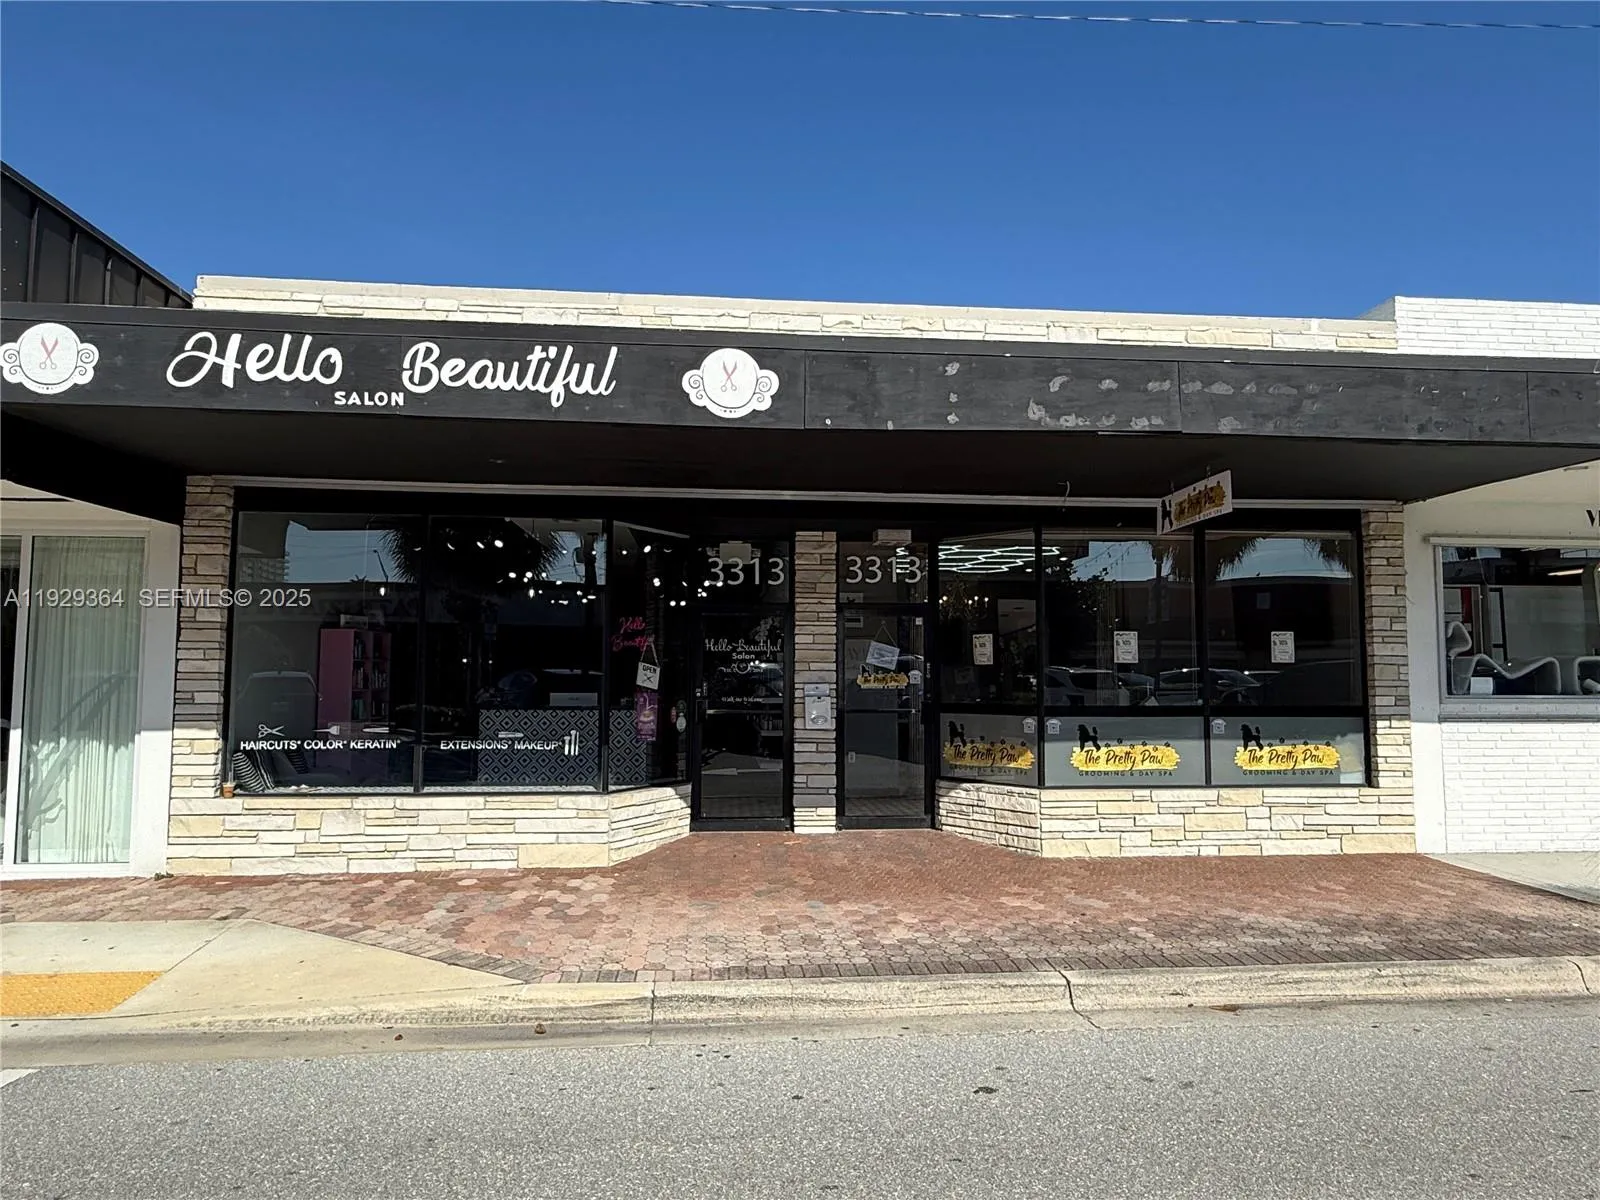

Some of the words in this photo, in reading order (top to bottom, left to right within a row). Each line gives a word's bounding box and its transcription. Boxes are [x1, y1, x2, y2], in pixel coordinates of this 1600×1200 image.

[166, 331, 343, 389] Hello
[402, 341, 618, 408] Beautiful
[334, 390, 405, 407] SALON
[707, 556, 785, 586] 3313
[846, 555, 922, 584] 3313
[704, 638, 733, 652] Hello
[732, 638, 782, 658] Beautiful
[732, 652, 755, 660] Salon
[642, 664, 657, 675] OPEN
[953, 744, 967, 760] The
[970, 745, 996, 768] Pretty
[998, 747, 1021, 763] Paw
[1084, 749, 1100, 765] The
[1105, 749, 1136, 771] Pretty
[1140, 749, 1164, 765] Paw
[1248, 749, 1264, 764] The
[1267, 749, 1299, 770] Pretty
[1302, 749, 1325, 765] Paw
